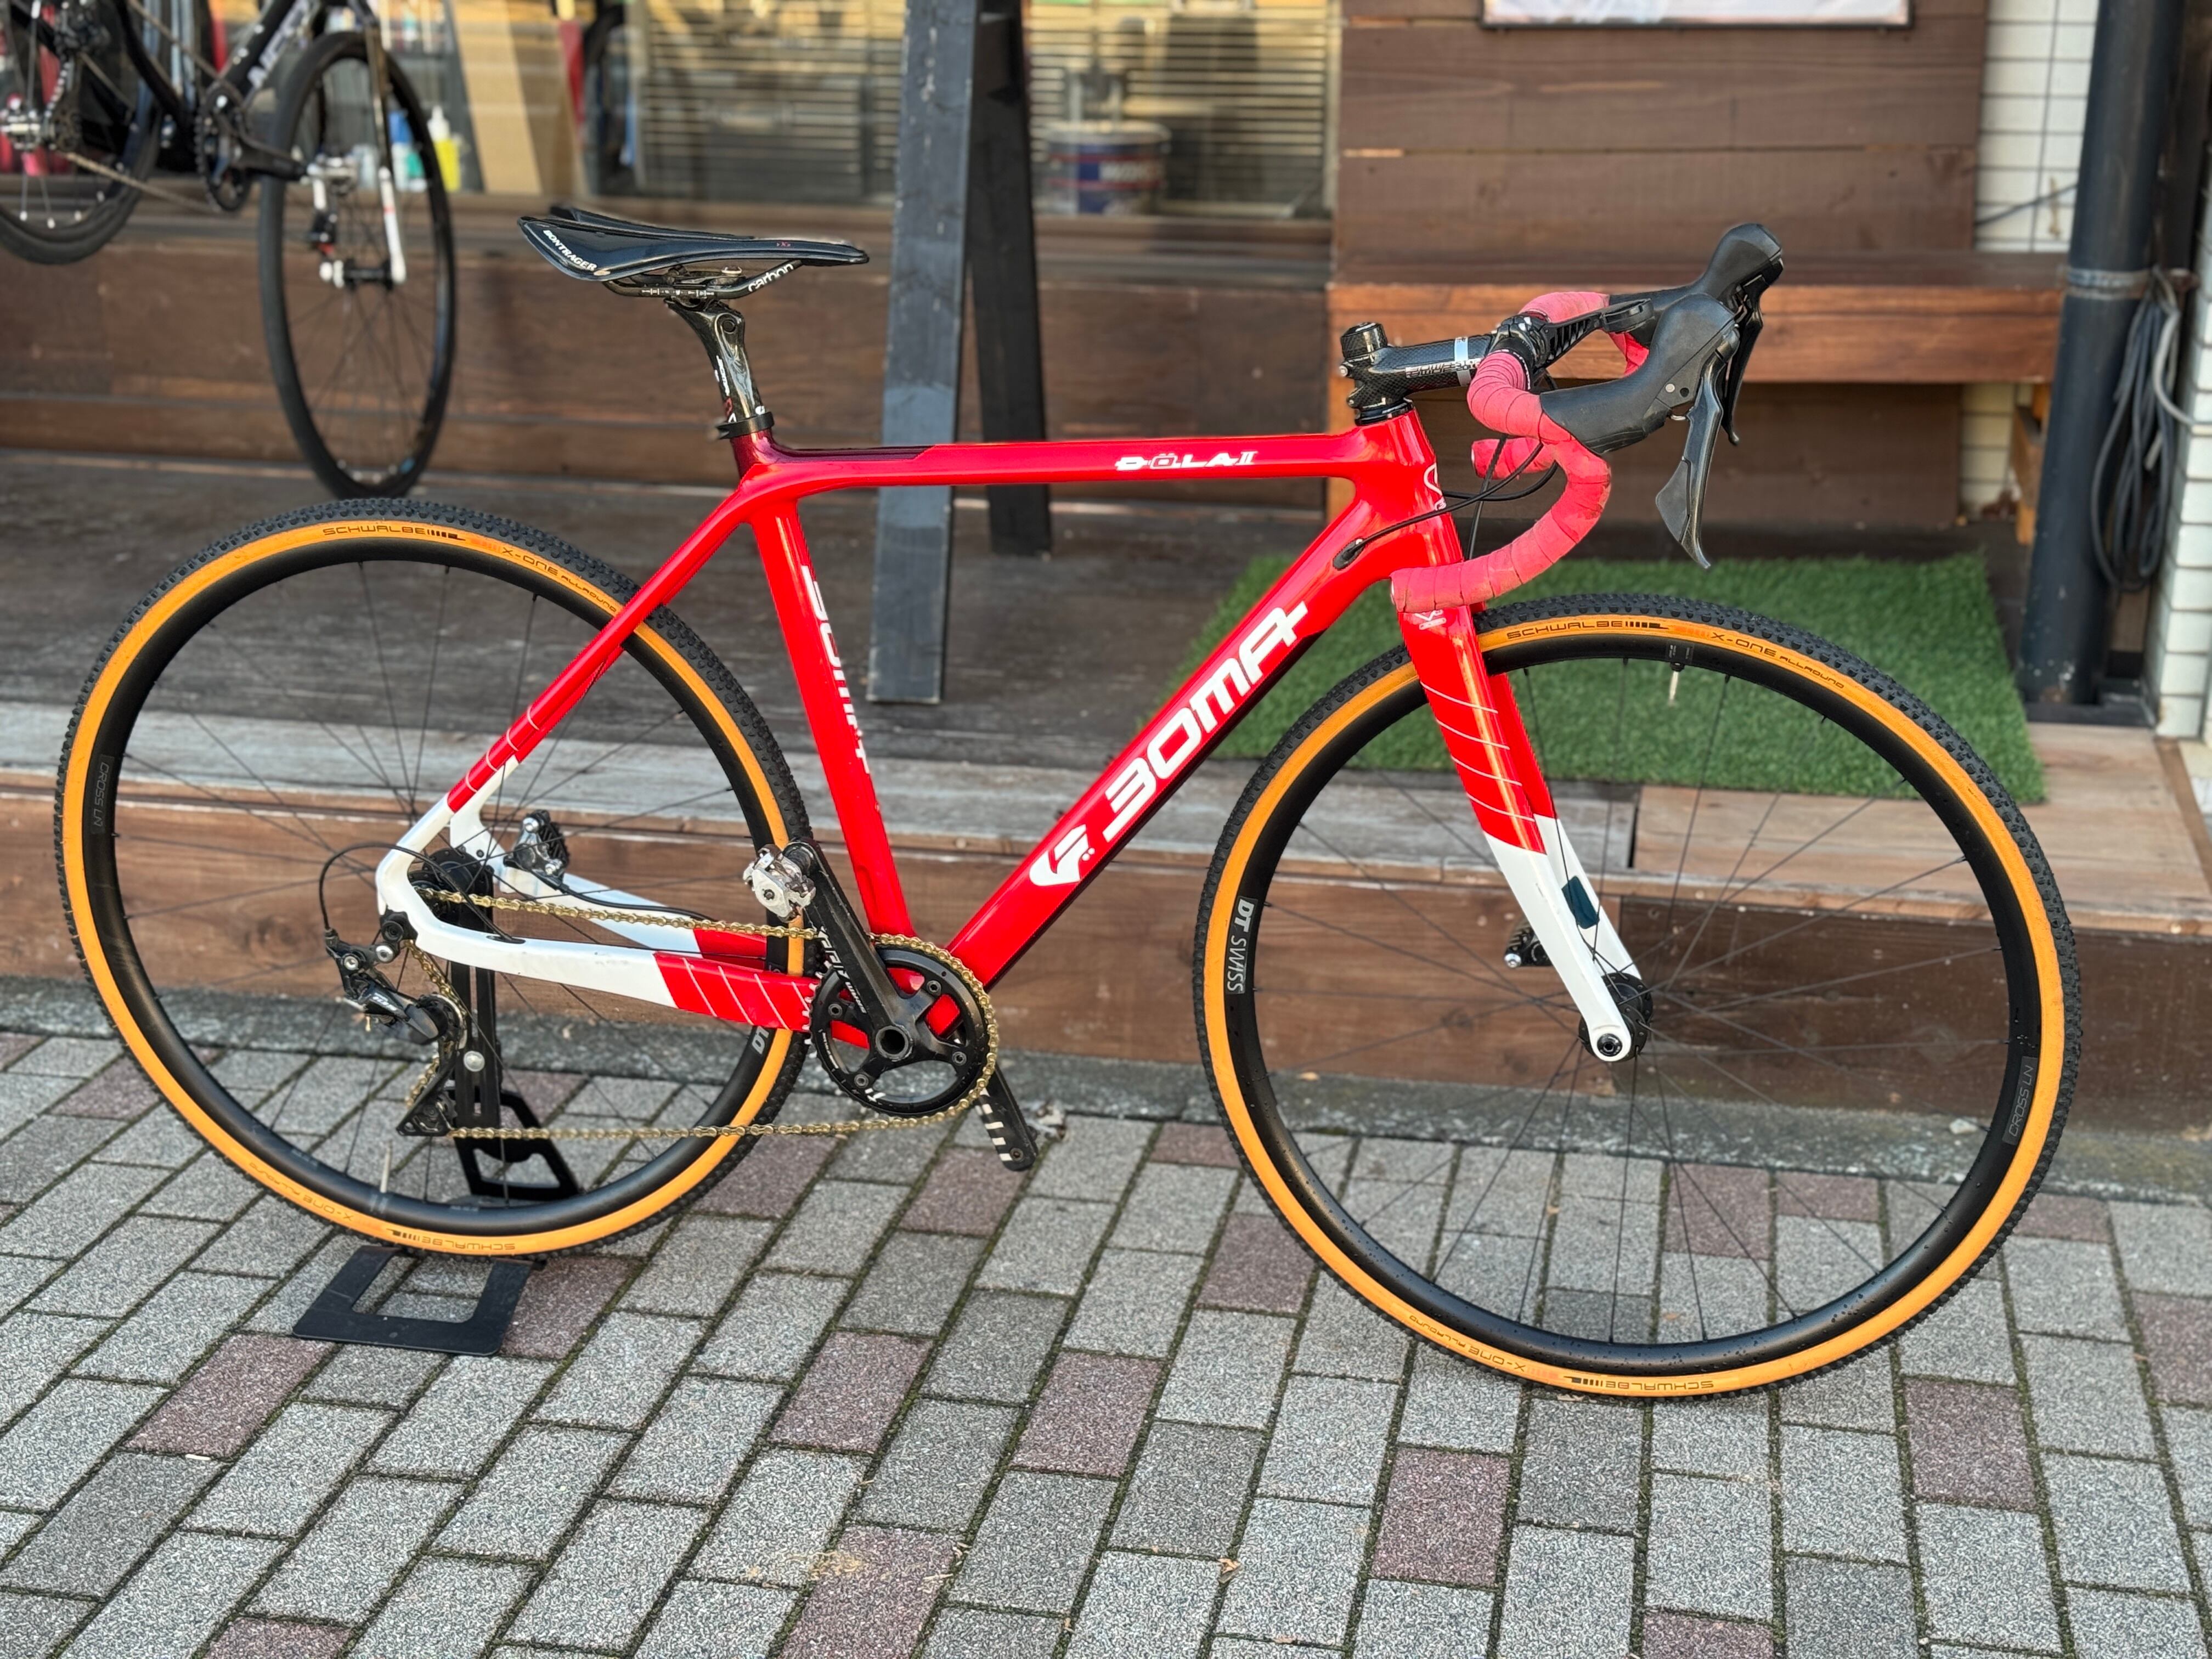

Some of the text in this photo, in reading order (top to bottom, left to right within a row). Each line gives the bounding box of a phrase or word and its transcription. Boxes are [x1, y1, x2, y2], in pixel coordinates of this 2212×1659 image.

[543, 229, 597, 272] BONTRAGER
[323, 525, 426, 536] SCHWALBE
[501, 546, 617, 613] X-ONE ALLROUND
[1506, 620, 1623, 640] SCHWALBE
[1711, 631, 1778, 657] X-ONE
[1779, 656, 1845, 689] ALLROUND
[94, 761, 110, 806] CROSS
[1227, 898, 1255, 992] DT SWISS
[2008, 1064, 2034, 1137] CROSS LN
[303, 1195, 354, 1221] X-ONE
[421, 1237, 516, 1250] SCHWALBE
[1408, 1314, 1527, 1373] X-ONE ALLROUND
[1605, 1380, 1714, 1391] SCHWALBE
